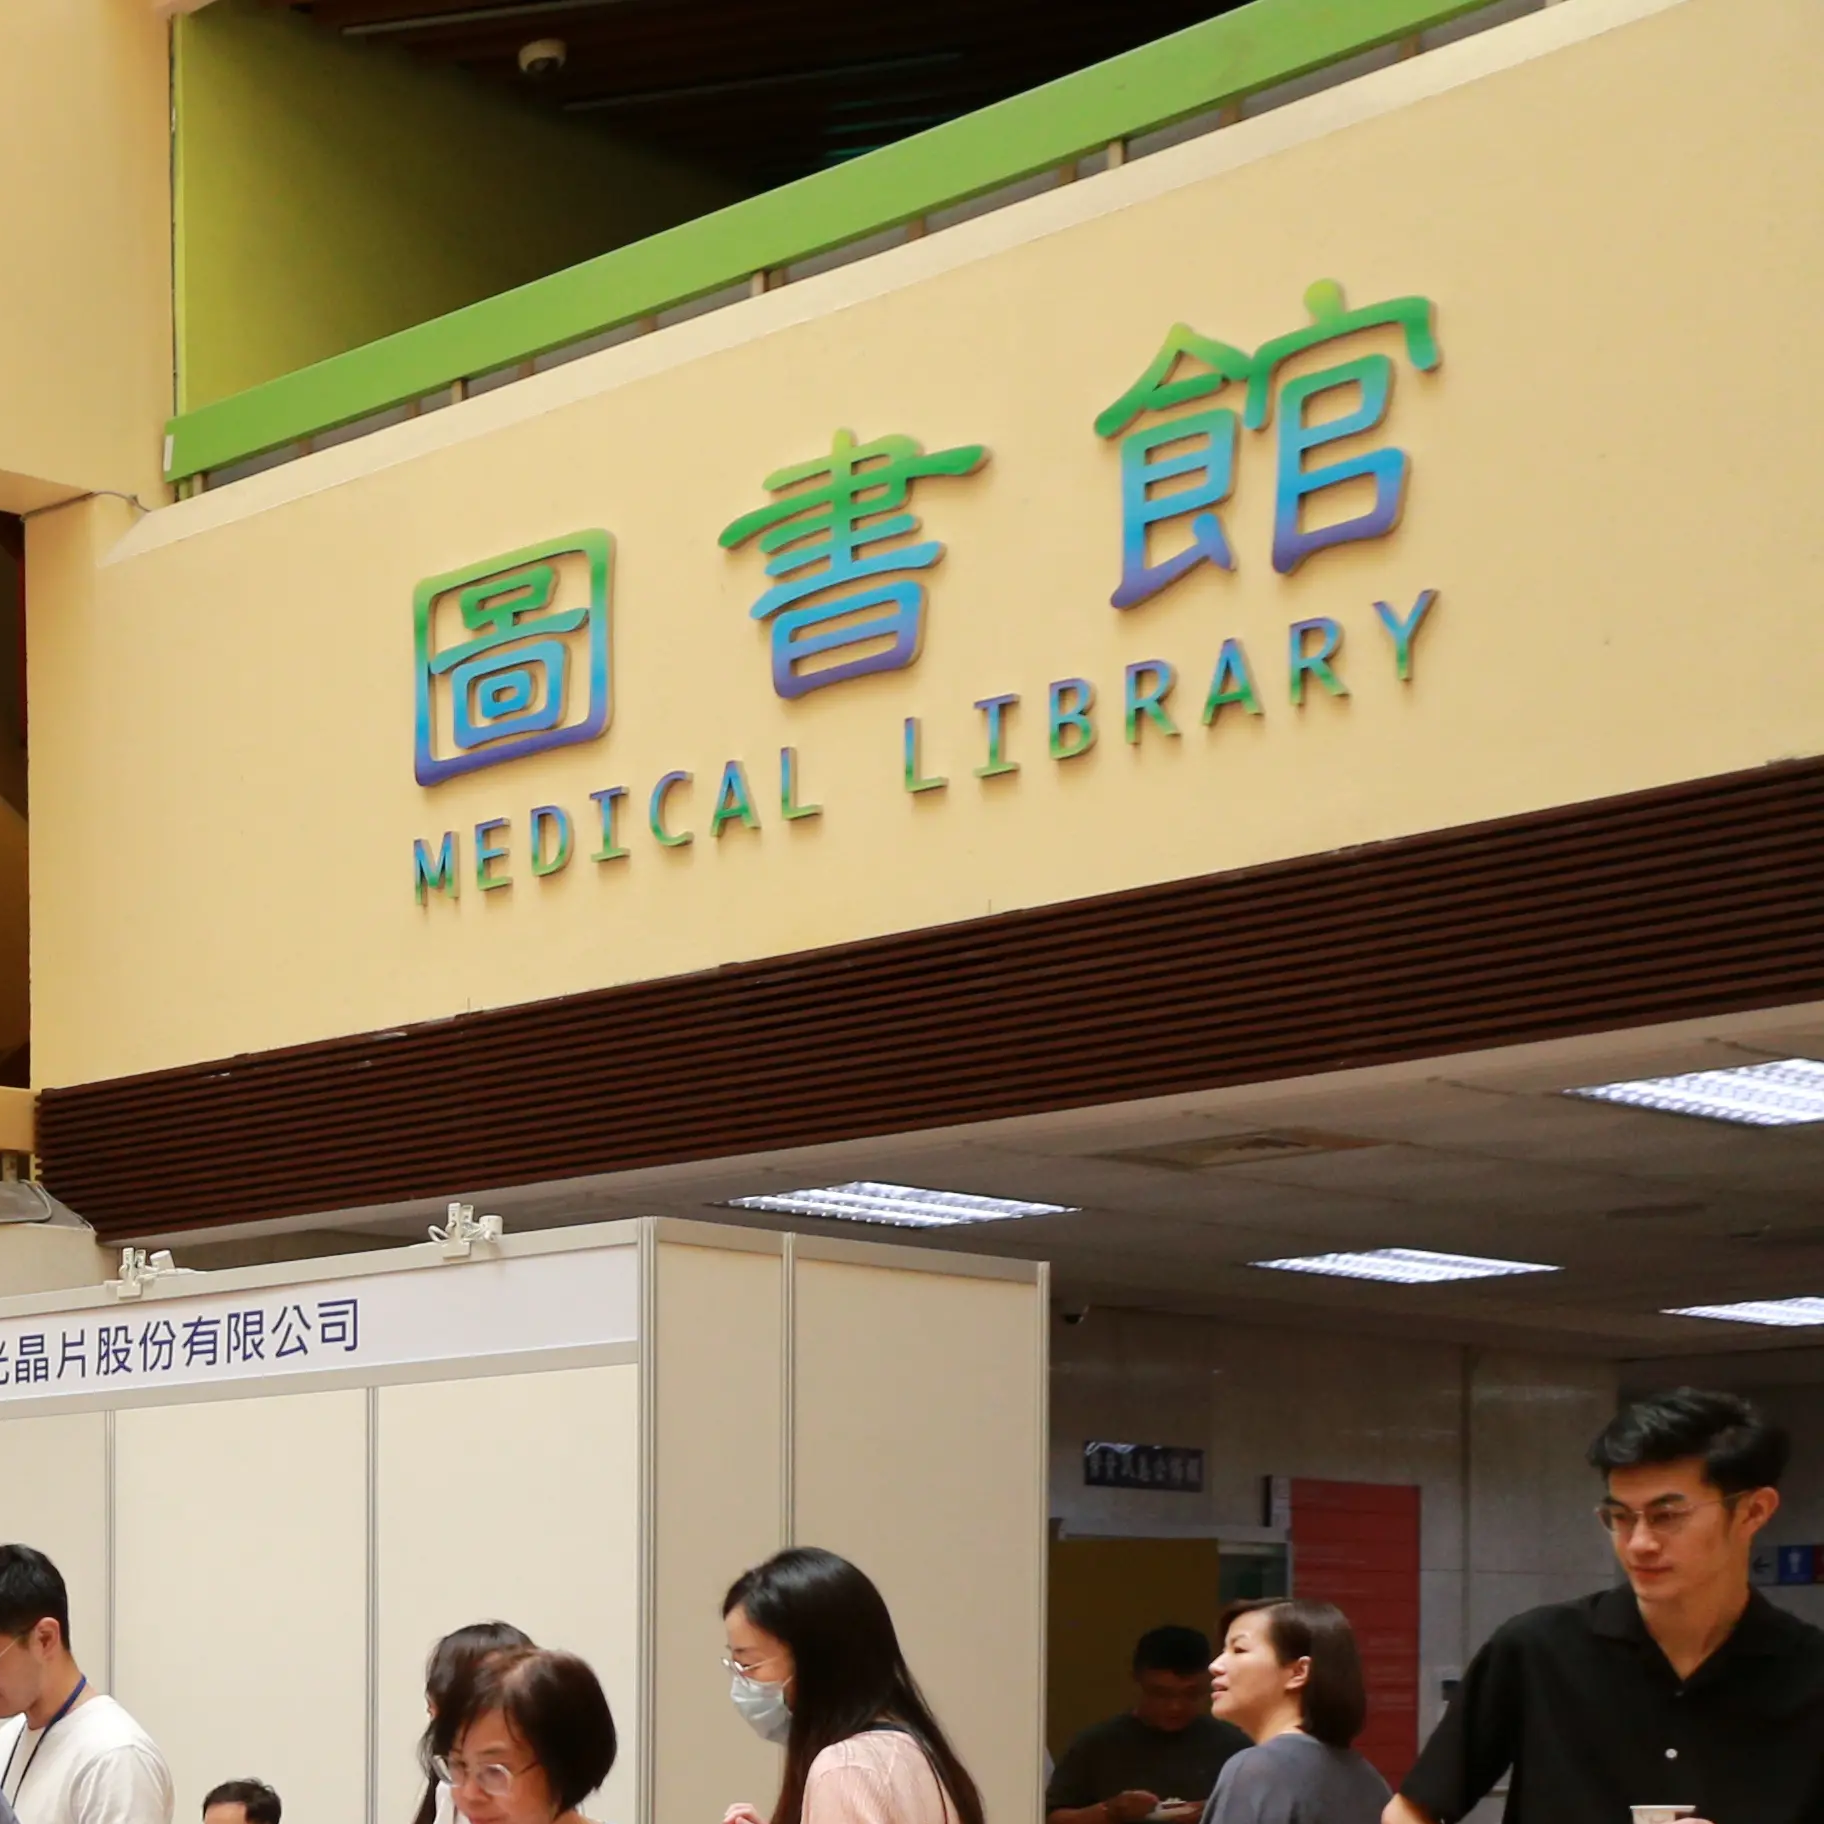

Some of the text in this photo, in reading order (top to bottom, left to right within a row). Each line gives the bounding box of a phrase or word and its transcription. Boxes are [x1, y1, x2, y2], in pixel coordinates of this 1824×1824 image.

[412, 278, 1440, 788] 圖書館
[413, 587, 1440, 906] MEDICAL LIBRARY
